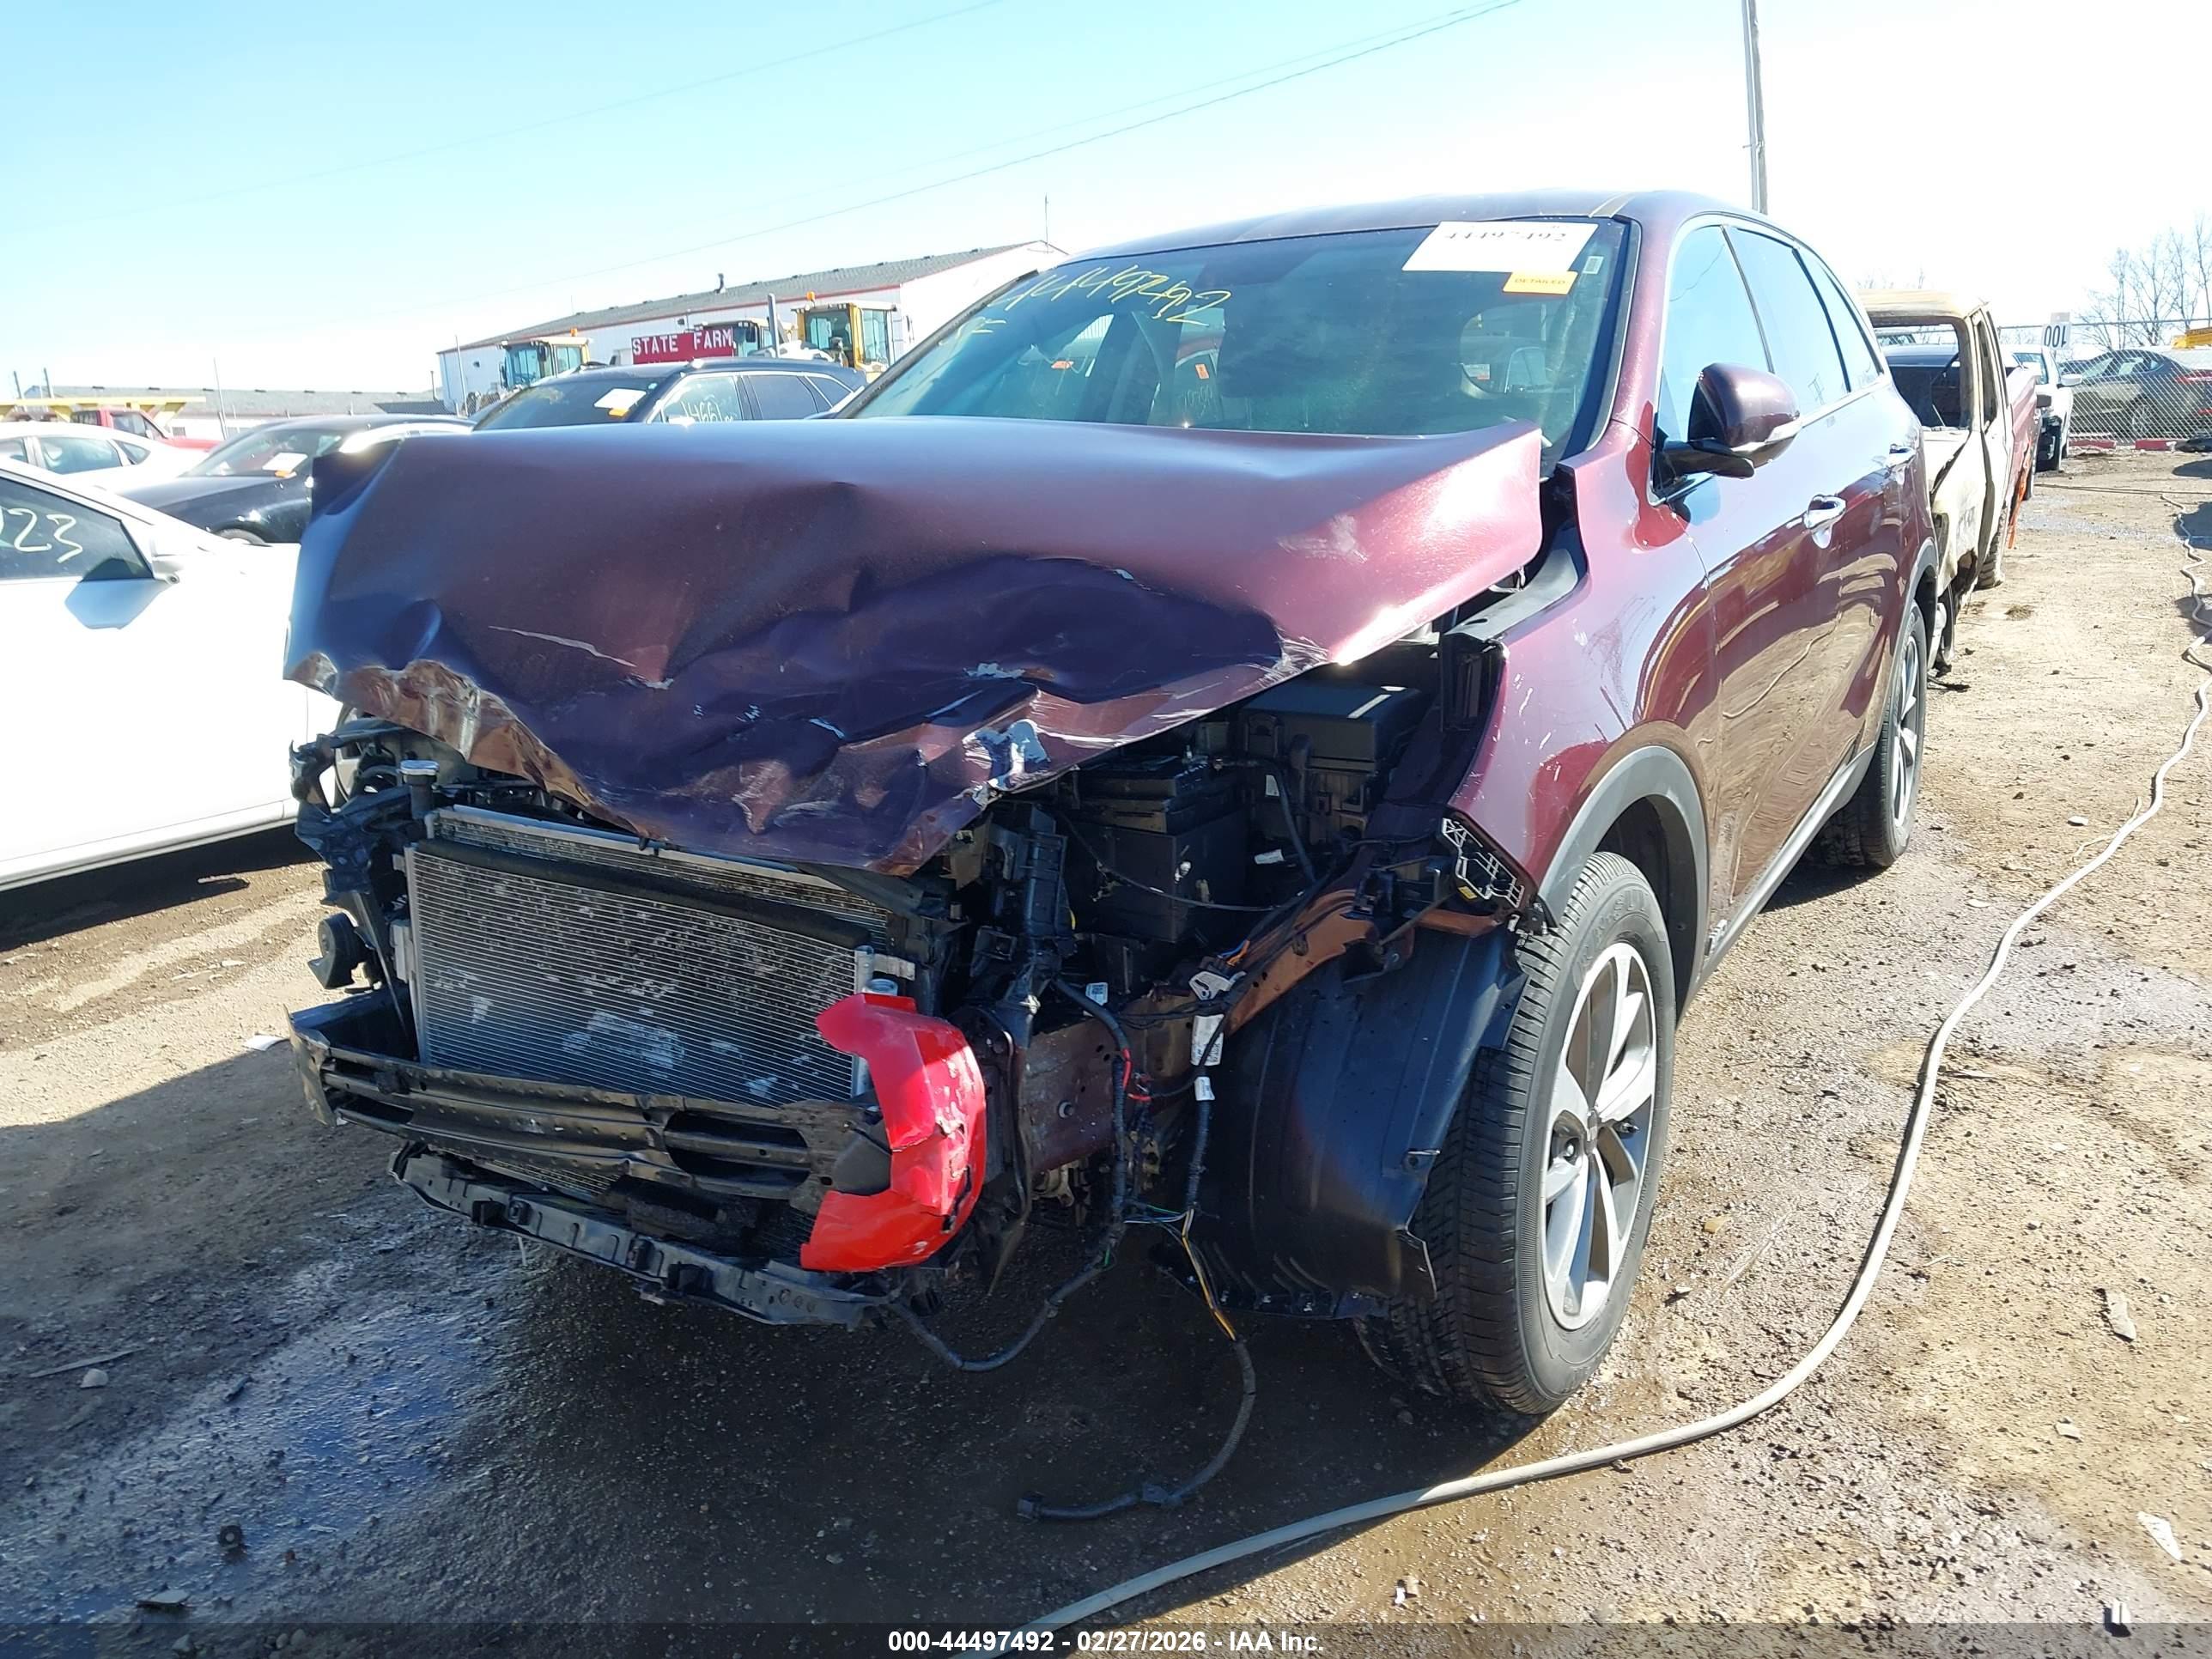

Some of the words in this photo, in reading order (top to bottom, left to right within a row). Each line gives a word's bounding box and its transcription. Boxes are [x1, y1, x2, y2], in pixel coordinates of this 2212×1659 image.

[1444, 231, 1567, 242] 4449492
[632, 334, 678, 356] STATE
[693, 327, 732, 350] FARM
[0, 505, 83, 563] 23
